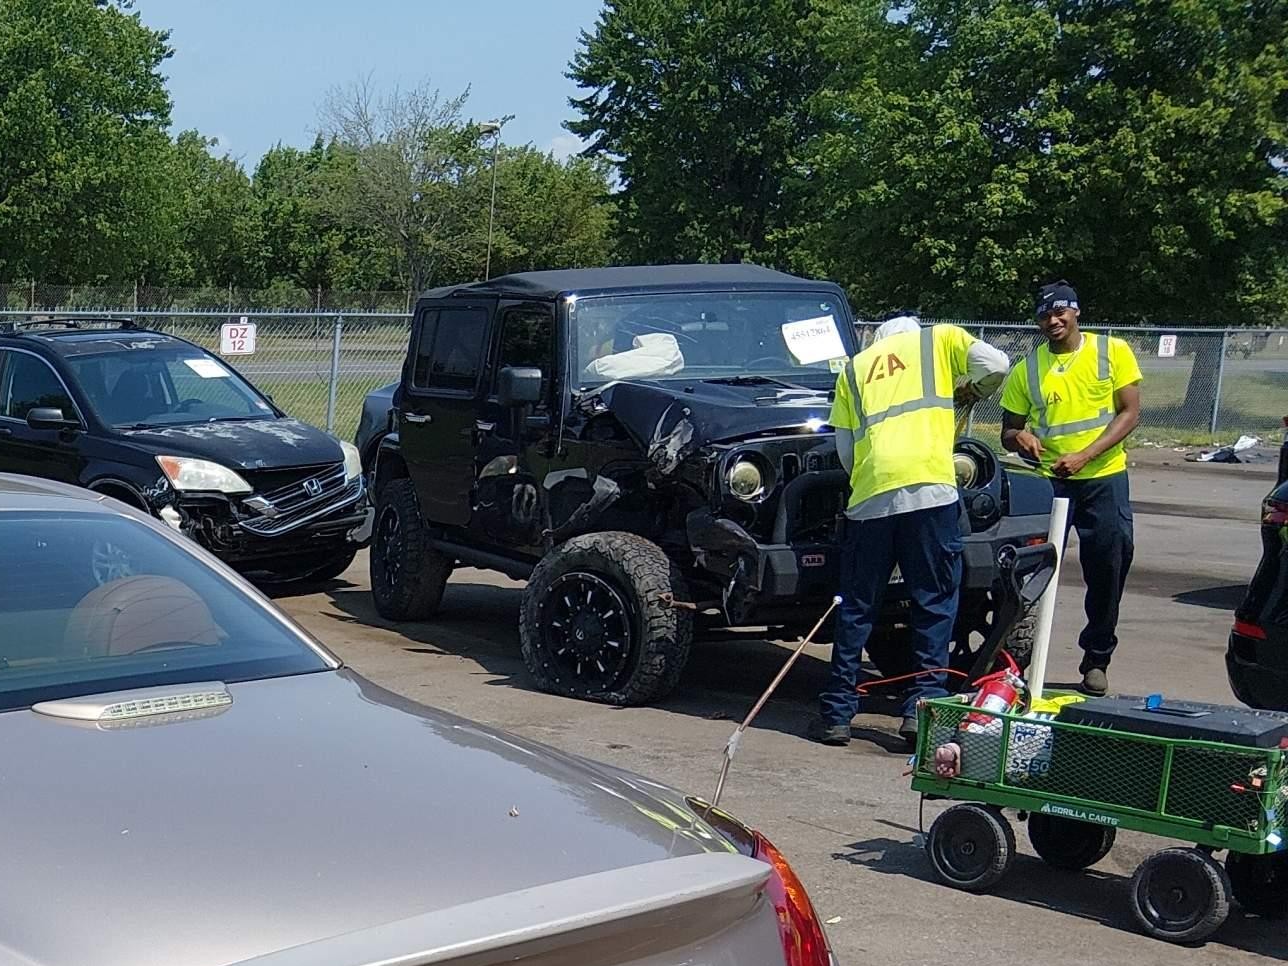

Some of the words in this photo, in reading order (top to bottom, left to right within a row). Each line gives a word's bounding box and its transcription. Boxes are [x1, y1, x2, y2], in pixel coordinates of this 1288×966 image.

[229, 327, 248, 339] DZ
[231, 340, 245, 351] 12
[1051, 804, 1087, 820] GORILLA
[1088, 812, 1119, 826] CARTS
